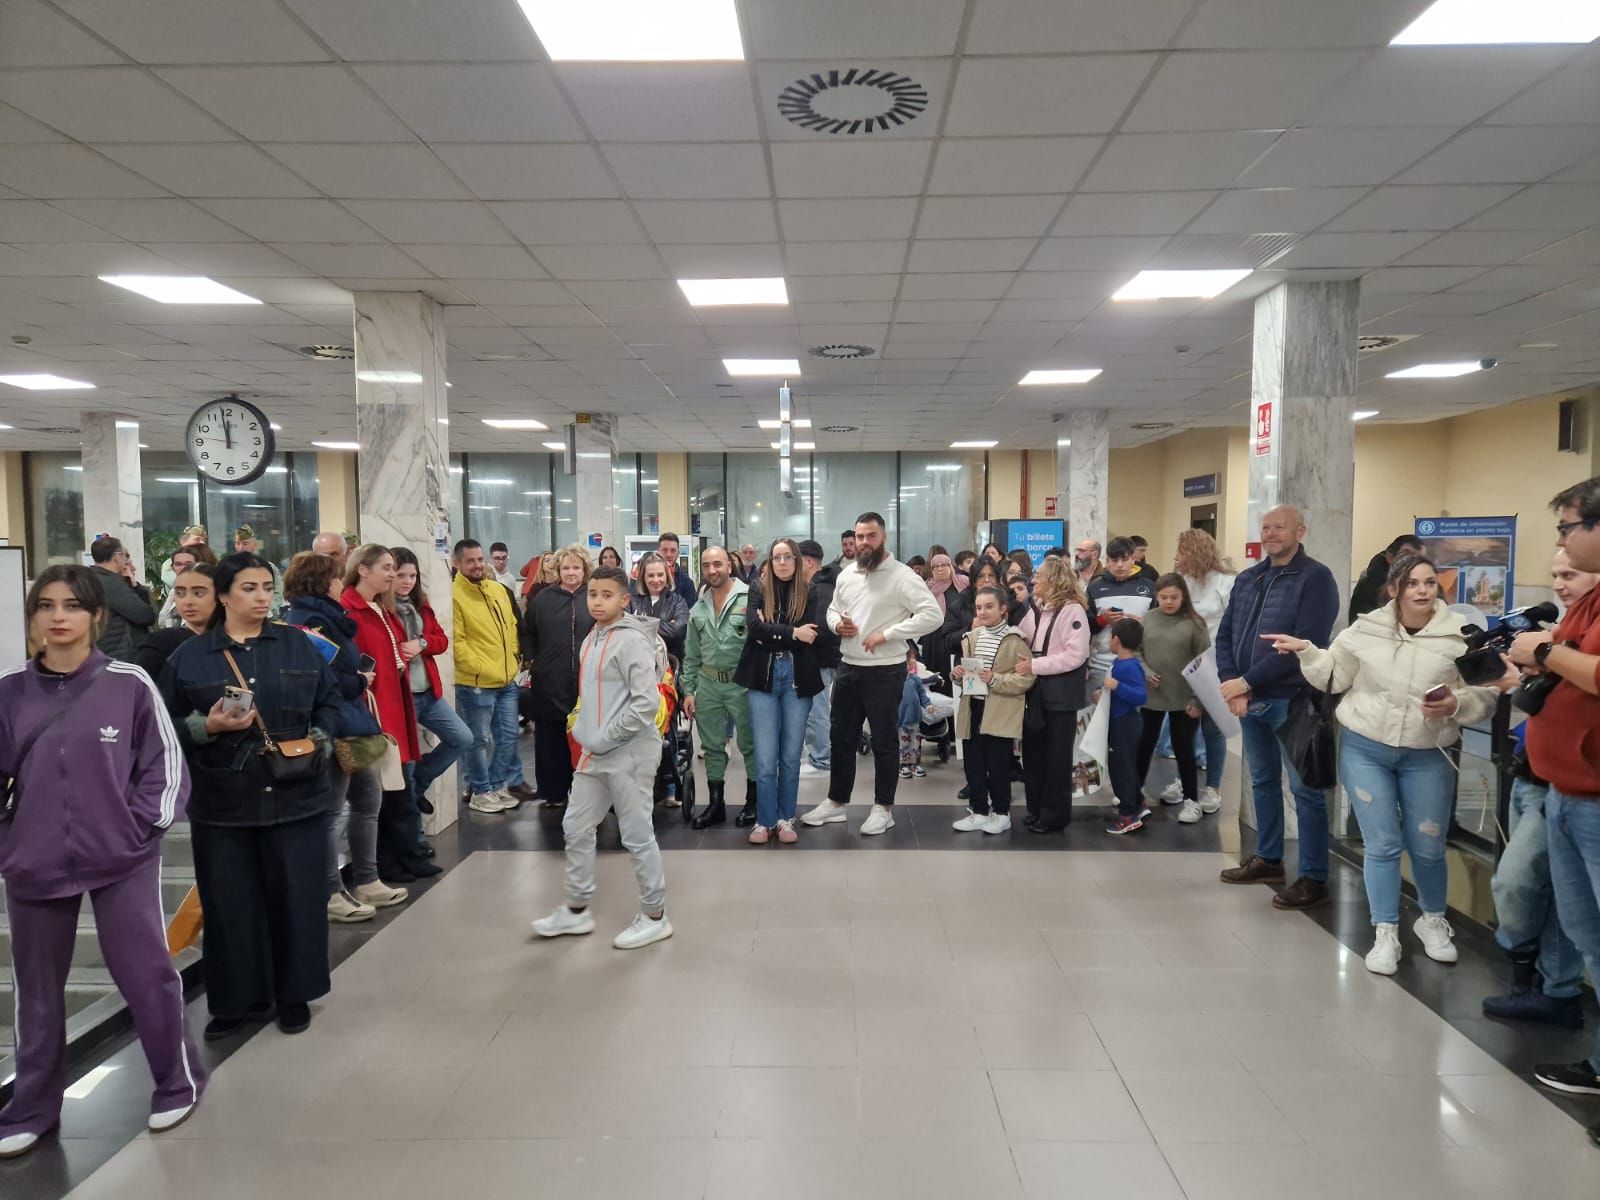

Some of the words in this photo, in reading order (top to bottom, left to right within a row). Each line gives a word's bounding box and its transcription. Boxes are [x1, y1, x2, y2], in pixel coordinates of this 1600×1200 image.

[222, 408, 233, 417] 12
[207, 413, 217, 422] 11
[198, 424, 210, 433] 10
[249, 422, 257, 431] 2
[195, 438, 204, 447] 9
[253, 437, 262, 446] 3
[200, 451, 210, 460] 8
[250, 450, 259, 458] 4
[212, 462, 222, 470] 7
[241, 461, 250, 470] 5
[226, 466, 235, 475] 6
[1026, 532, 1055, 541] billete
